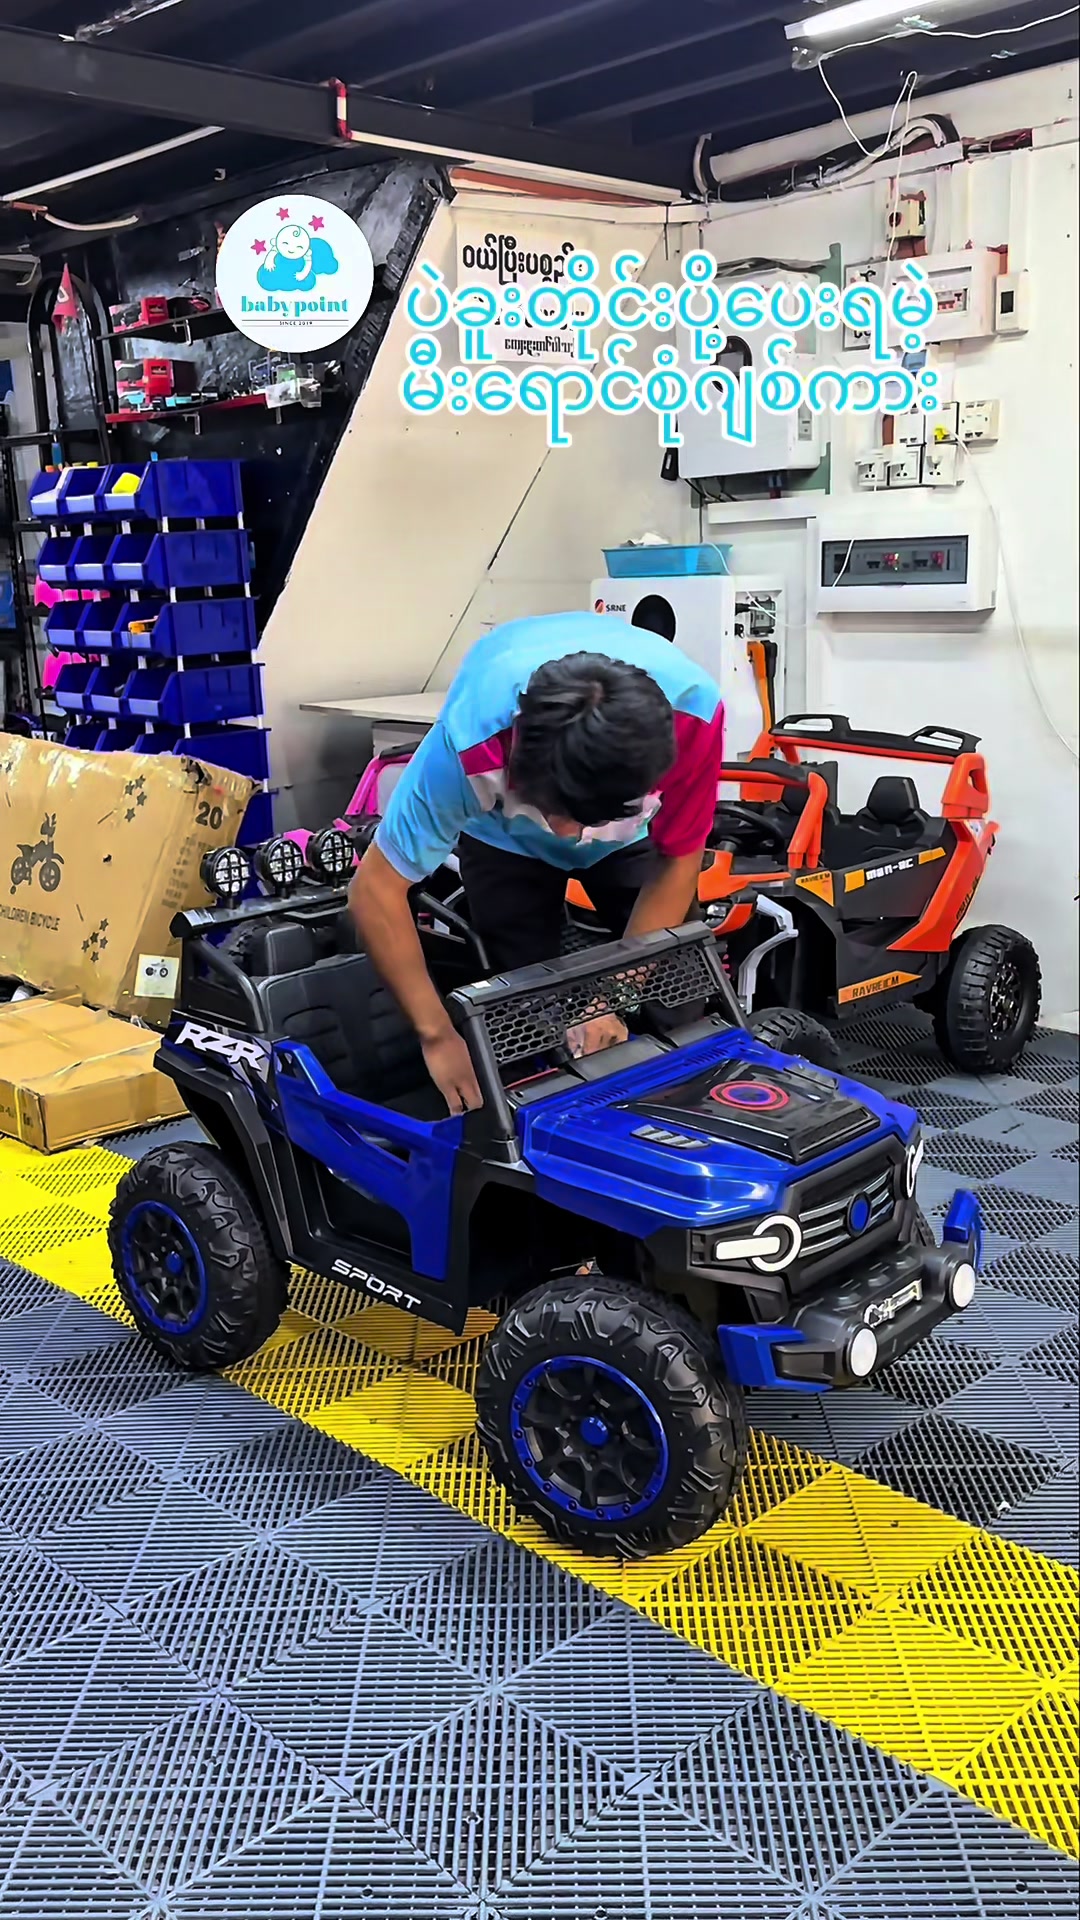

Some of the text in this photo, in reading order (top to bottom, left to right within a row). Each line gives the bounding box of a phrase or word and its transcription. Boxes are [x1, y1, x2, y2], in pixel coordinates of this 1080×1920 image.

[606, 604, 626, 612] SRNE
[195, 801, 223, 829] 20
[174, 1021, 267, 1071] RZR
[331, 1258, 421, 1309] SPORT
